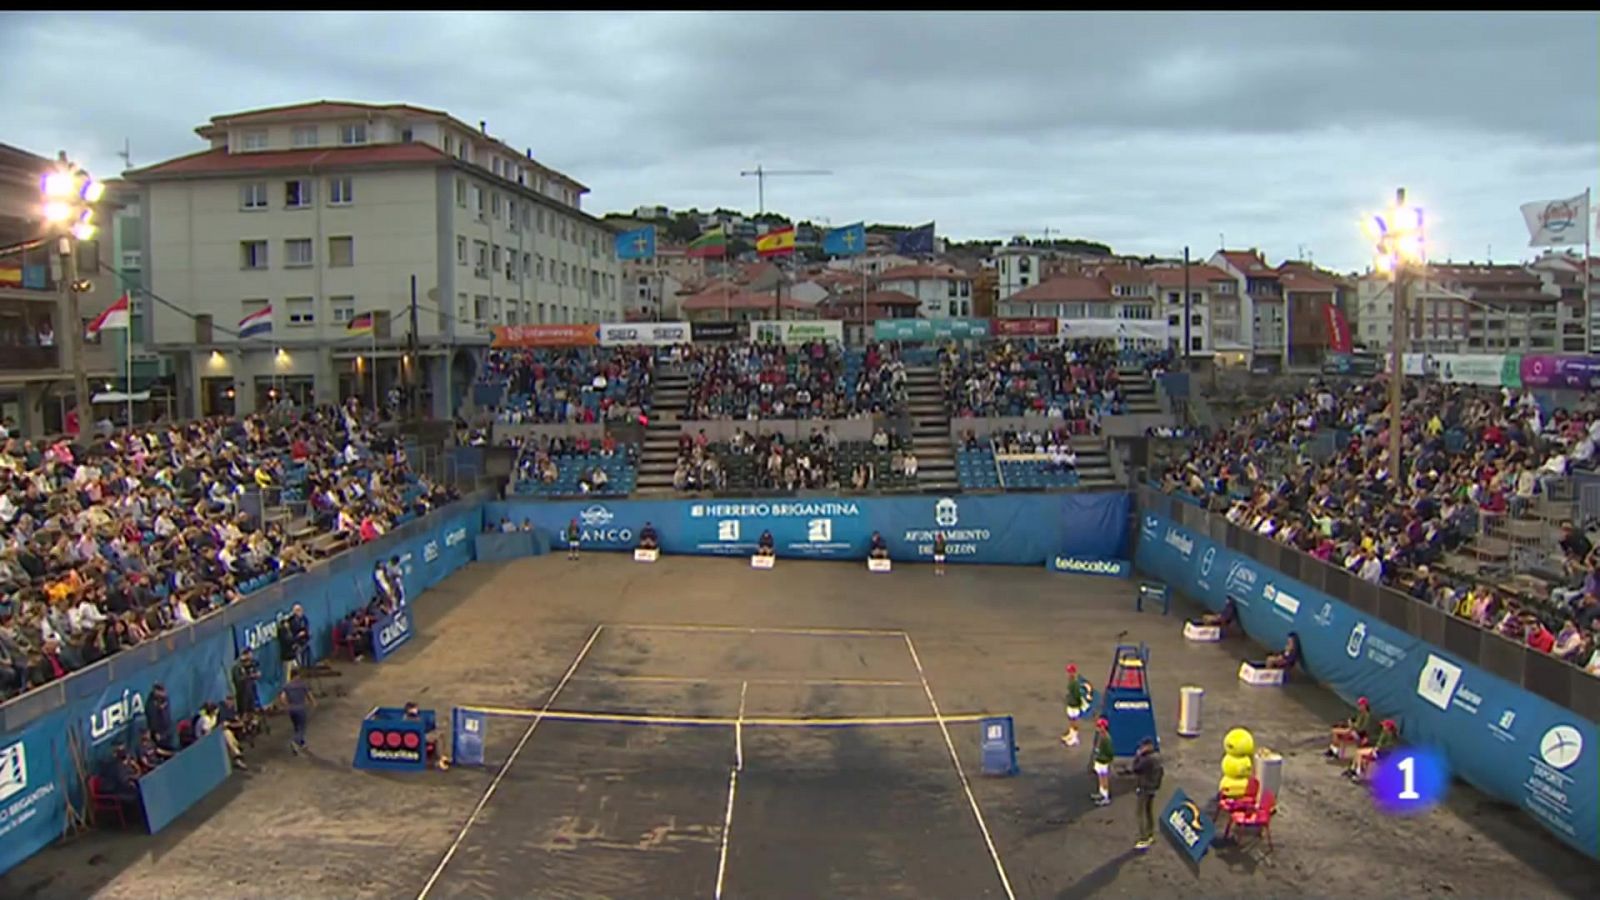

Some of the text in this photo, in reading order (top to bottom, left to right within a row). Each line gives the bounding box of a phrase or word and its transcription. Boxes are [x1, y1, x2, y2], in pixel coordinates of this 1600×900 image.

[706, 503, 859, 517] HERRERO BRIGANTINA
[560, 528, 632, 542] LANCO
[1055, 555, 1121, 574] telecable
[90, 688, 145, 738] URÍA
